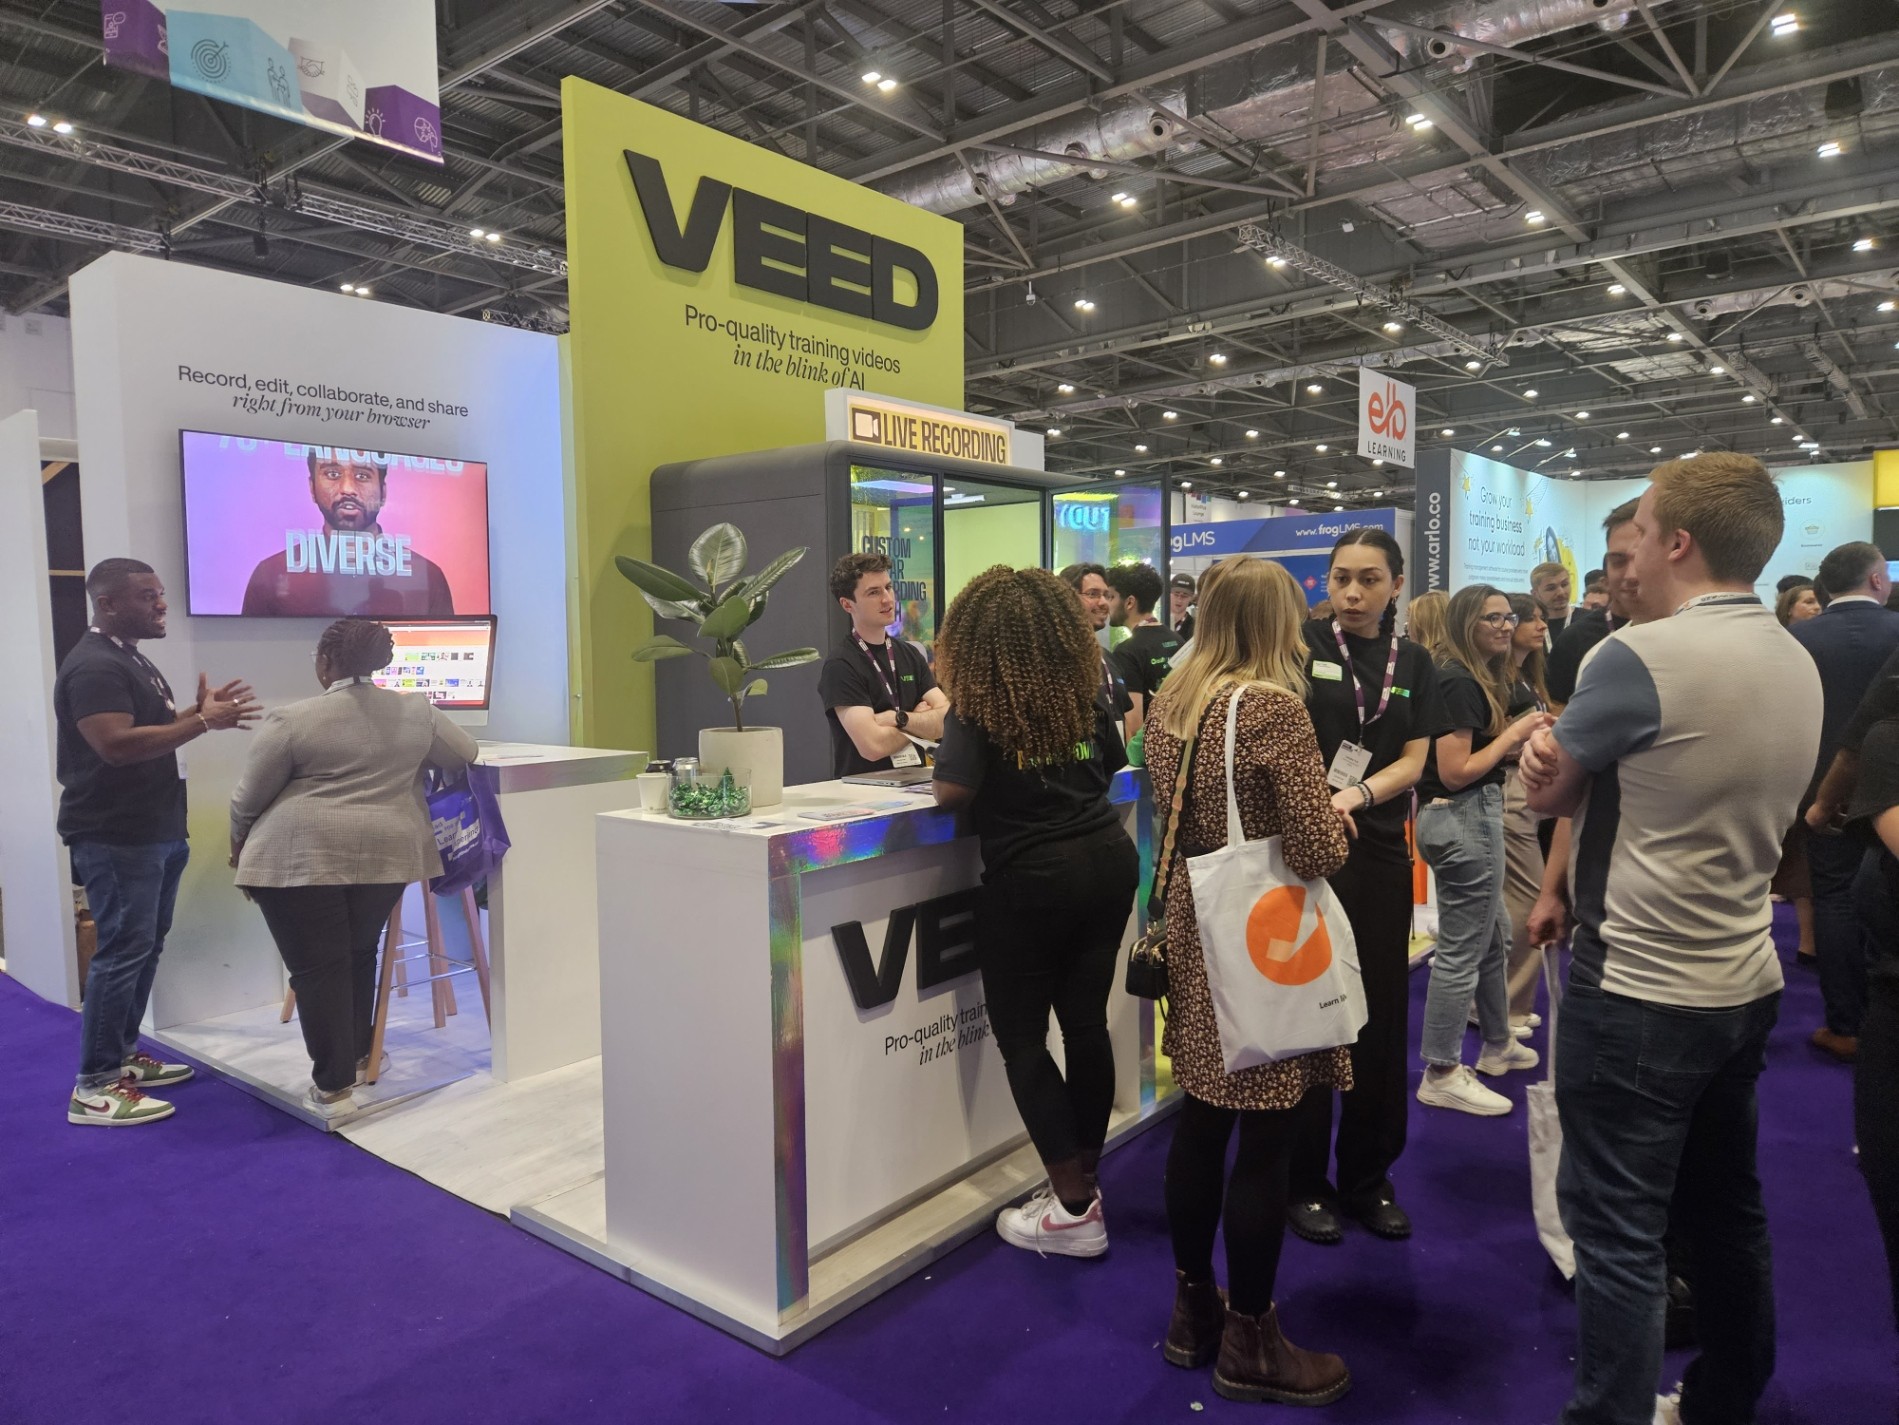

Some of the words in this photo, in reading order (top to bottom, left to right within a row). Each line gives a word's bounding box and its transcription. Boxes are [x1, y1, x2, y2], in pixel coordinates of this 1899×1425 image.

[623, 149, 939, 331] VEED
[685, 304, 786, 350] Pro-quality
[789, 330, 849, 366] training
[852, 348, 901, 374] videos
[733, 344, 752, 367] in
[755, 349, 783, 374] the
[785, 354, 829, 384] blink
[831, 367, 850, 389] of
[850, 370, 865, 391] AI
[178, 365, 252, 390] Record,
[255, 377, 293, 396] edit,
[296, 383, 393, 410] collaborate,
[395, 396, 425, 412] and
[428, 397, 469, 417] share
[232, 392, 276, 415] right
[276, 396, 321, 417] from
[321, 406, 364, 422] your
[367, 410, 430, 430] browser
[883, 413, 918, 450] LIVE
[921, 420, 1006, 464] RECORDING
[1368, 441, 1406, 462] LEARNING
[1480, 486, 1498, 504] Grow
[1498, 495, 1512, 510] your
[1782, 497, 1812, 505] iders
[1171, 530, 1216, 552] gLMS
[1424, 492, 1441, 593] ww.arlo.co
[1469, 511, 1495, 533] training
[1496, 516, 1523, 534] business
[285, 528, 412, 577] DIVERSE
[862, 535, 911, 559] CUSTOM
[1468, 537, 1480, 551] not
[1480, 540, 1496, 557] your
[1496, 542, 1526, 557] workload
[831, 886, 984, 1010] VE
[1319, 998, 1339, 1009] Learn
[885, 1013, 958, 1056] Pro-quality
[960, 1002, 989, 1025] train
[918, 1046, 932, 1066] in
[935, 1036, 956, 1060] the
[957, 1021, 990, 1050] blink
